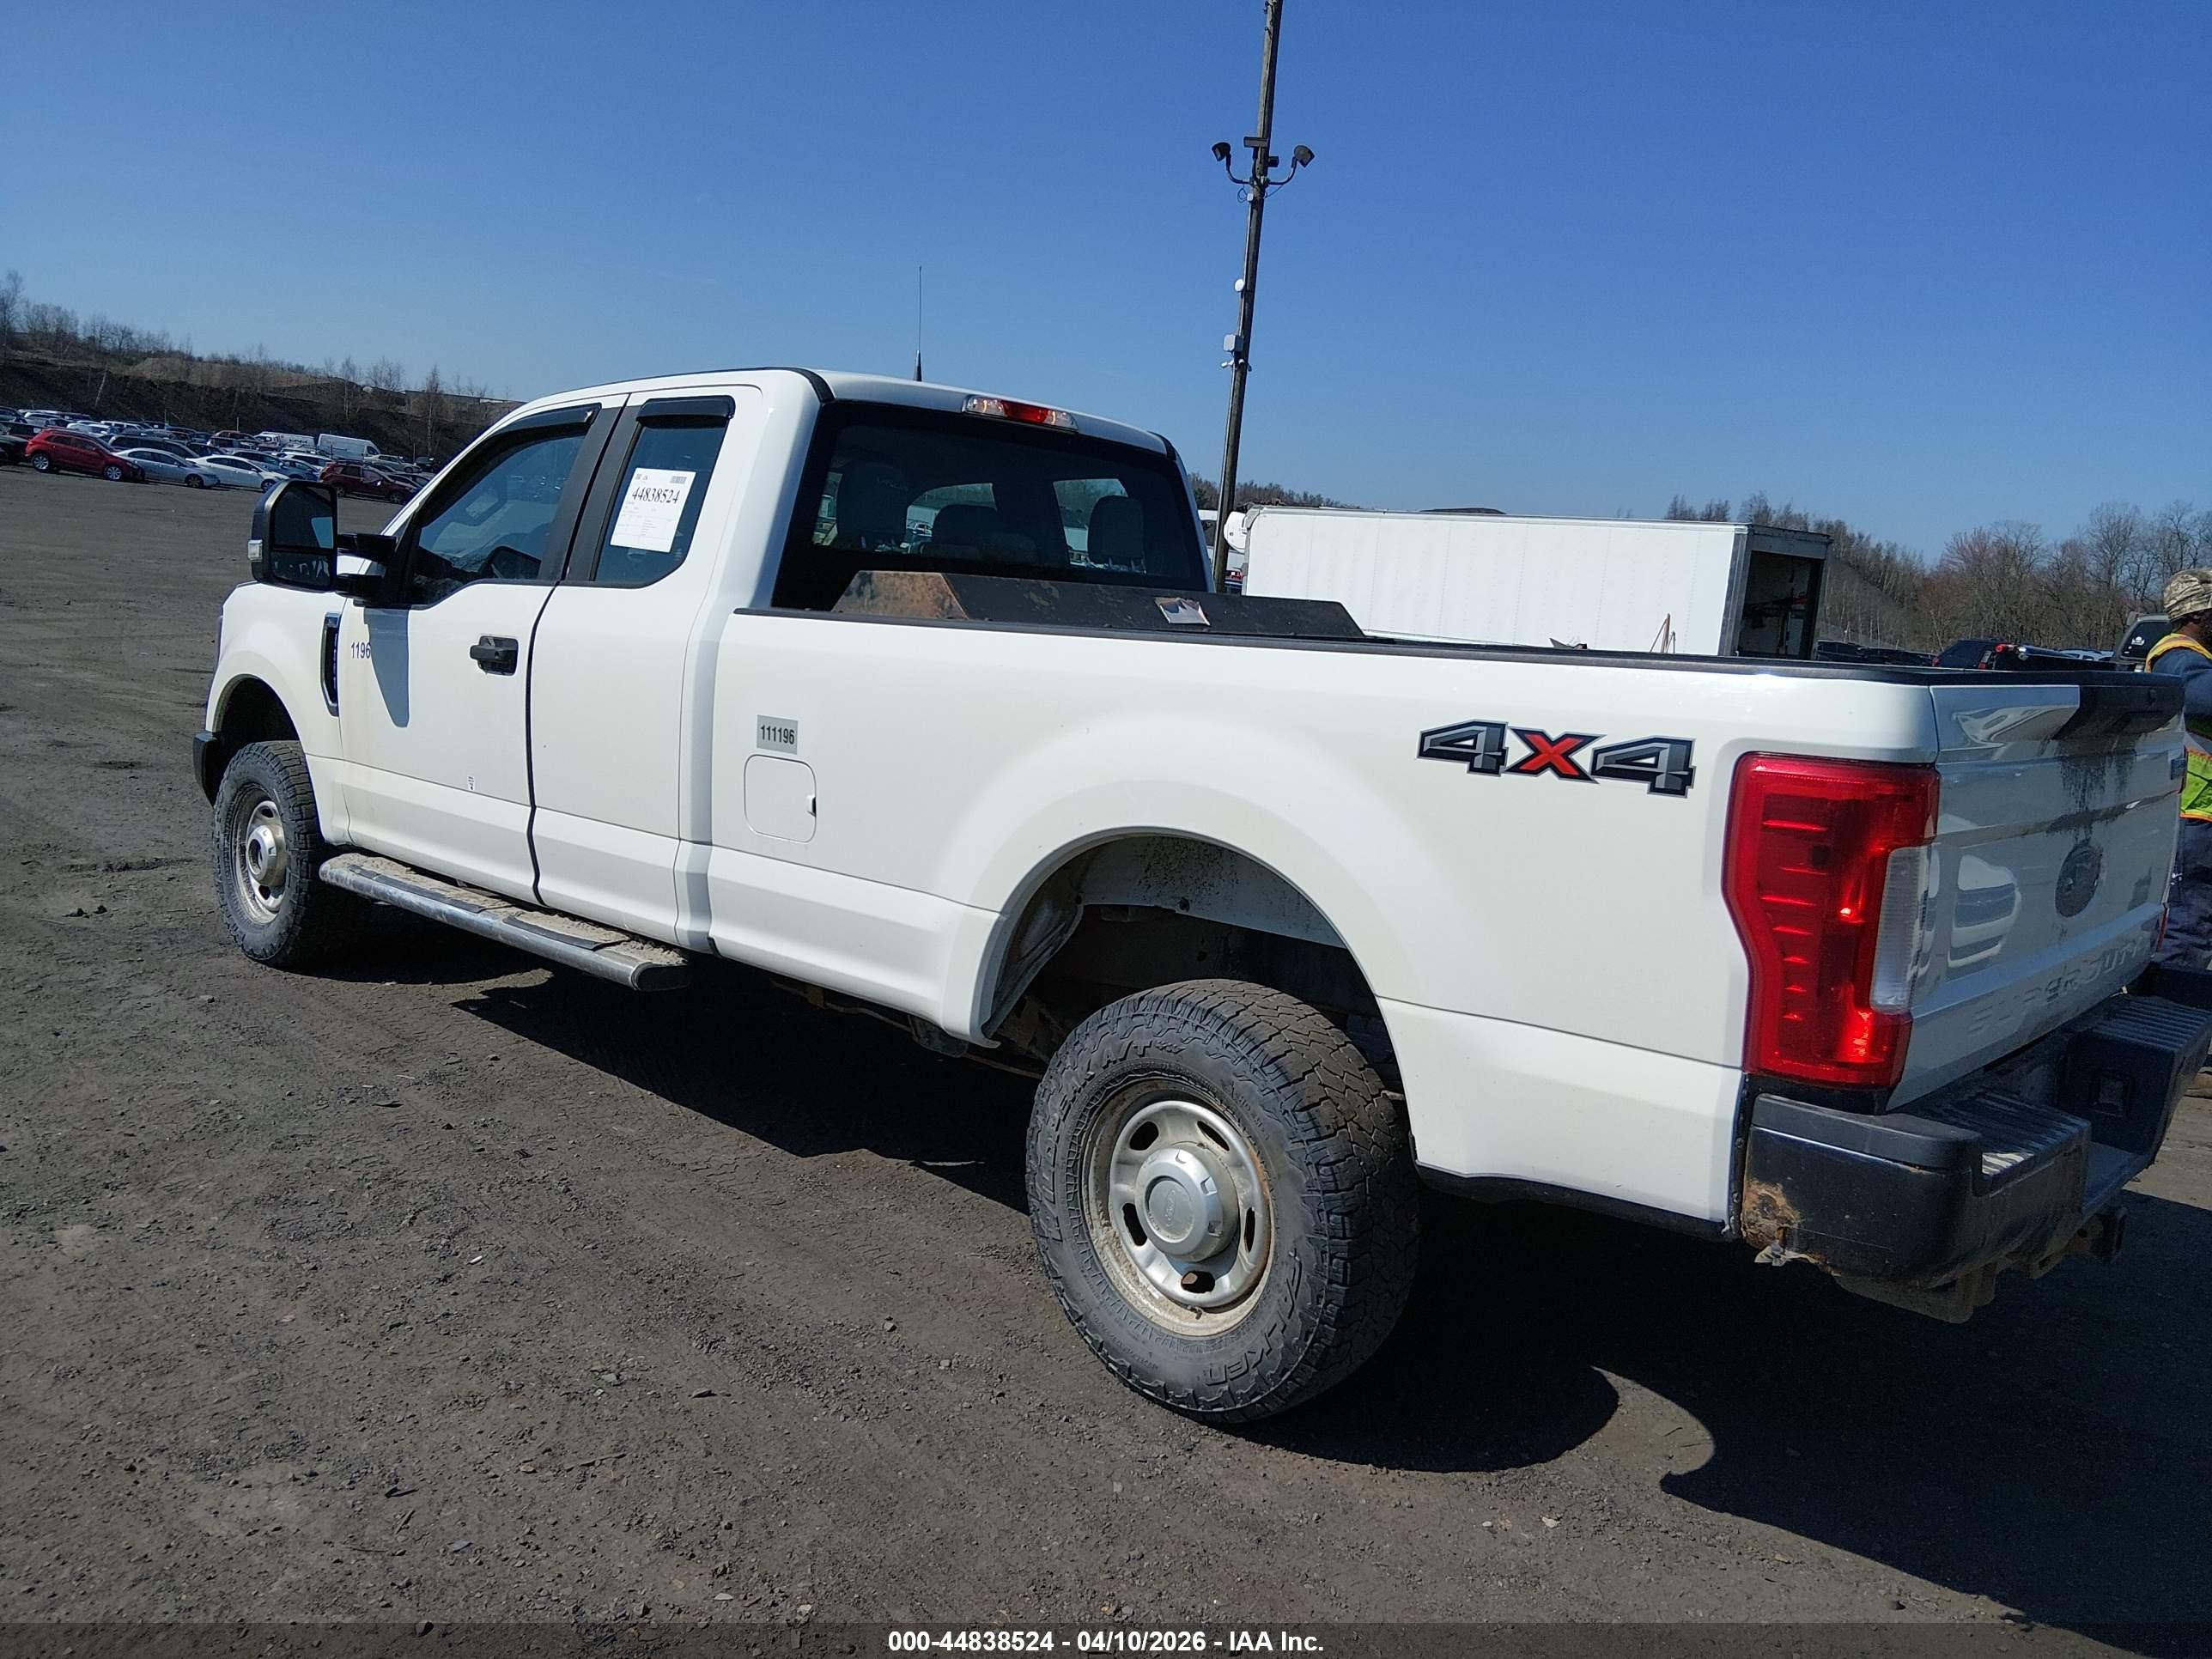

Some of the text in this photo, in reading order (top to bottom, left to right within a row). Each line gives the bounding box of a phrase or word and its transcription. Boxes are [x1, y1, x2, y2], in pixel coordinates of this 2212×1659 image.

[632, 486, 680, 504] 44838524
[350, 641, 371, 659] 1196
[760, 724, 795, 744] 111196
